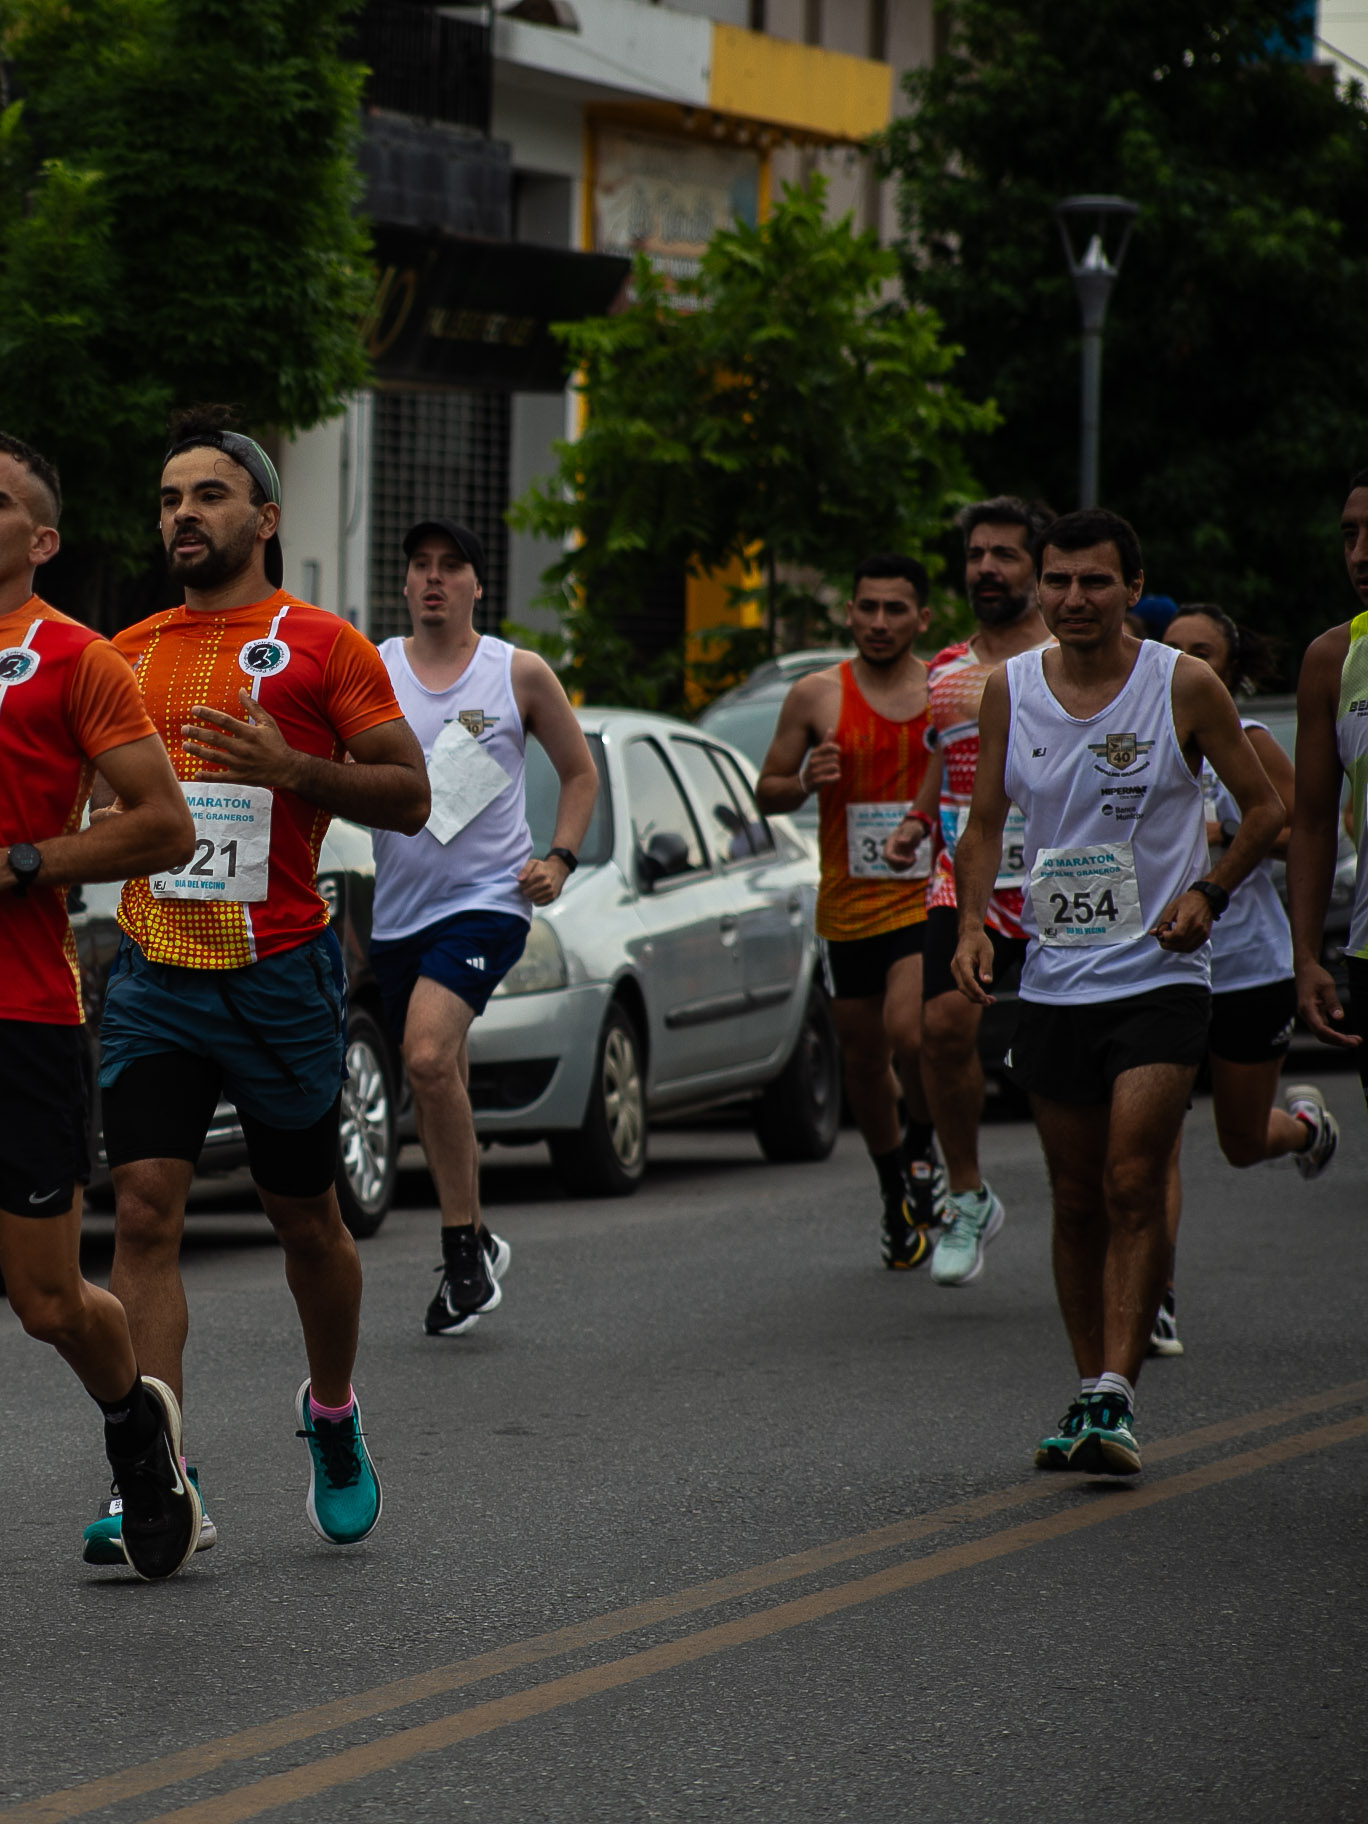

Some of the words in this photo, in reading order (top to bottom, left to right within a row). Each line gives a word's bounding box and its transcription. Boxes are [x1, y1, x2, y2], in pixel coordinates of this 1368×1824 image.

[1114, 752, 1130, 762] 40
[206, 812, 254, 822] GRANEROS
[167, 839, 238, 878] 21
[1056, 854, 1115, 868] MARATON
[154, 880, 166, 890] NEJ
[175, 880, 186, 888] DIA
[188, 880, 200, 888] DEL
[201, 881, 226, 890] VECINO
[1049, 889, 1119, 924] 254
